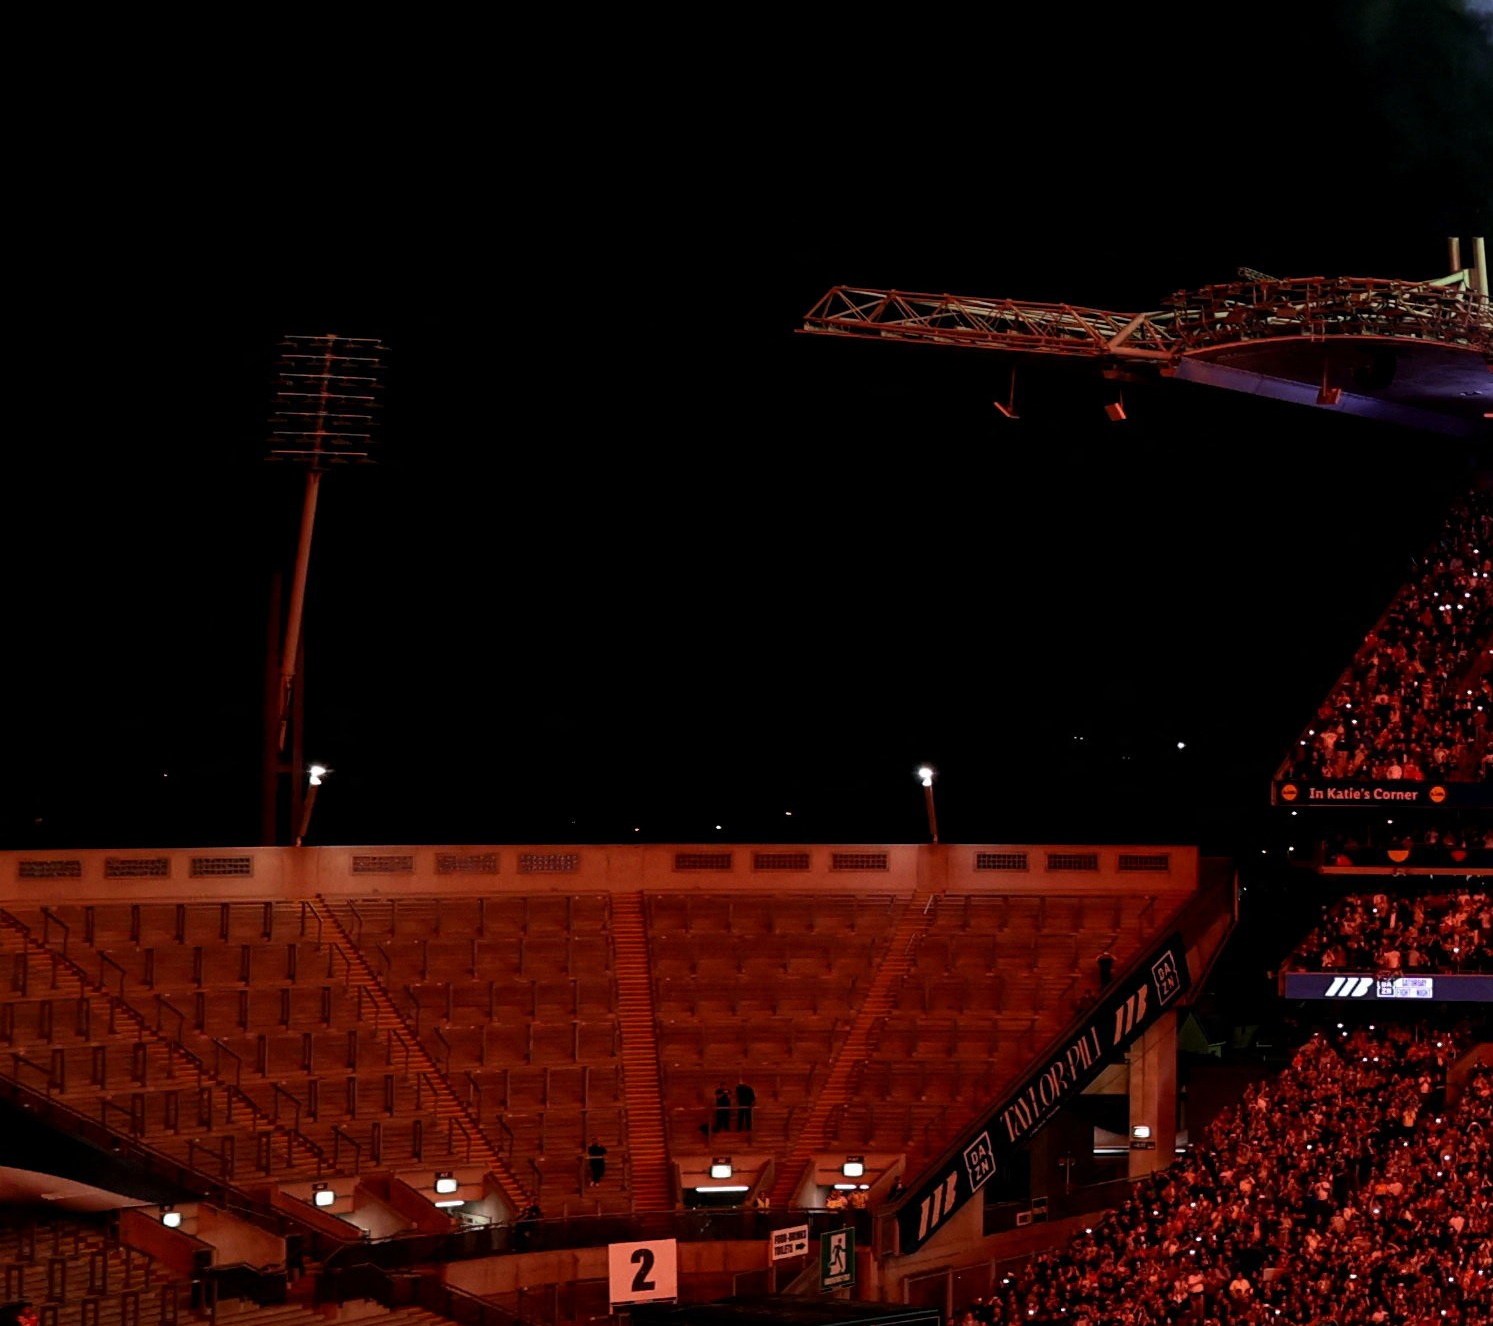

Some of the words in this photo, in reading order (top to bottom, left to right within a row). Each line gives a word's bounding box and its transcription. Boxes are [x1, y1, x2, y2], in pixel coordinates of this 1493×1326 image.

[1310, 788, 1323, 798] In
[1328, 788, 1370, 799] Katie's
[1374, 788, 1417, 800] Corner
[1157, 962, 1171, 981] DA
[1001, 1061, 1068, 1143] TAYLOR
[971, 1144, 985, 1165] DA
[975, 1161, 989, 1181] ZN
[631, 1248, 656, 1292] 2
